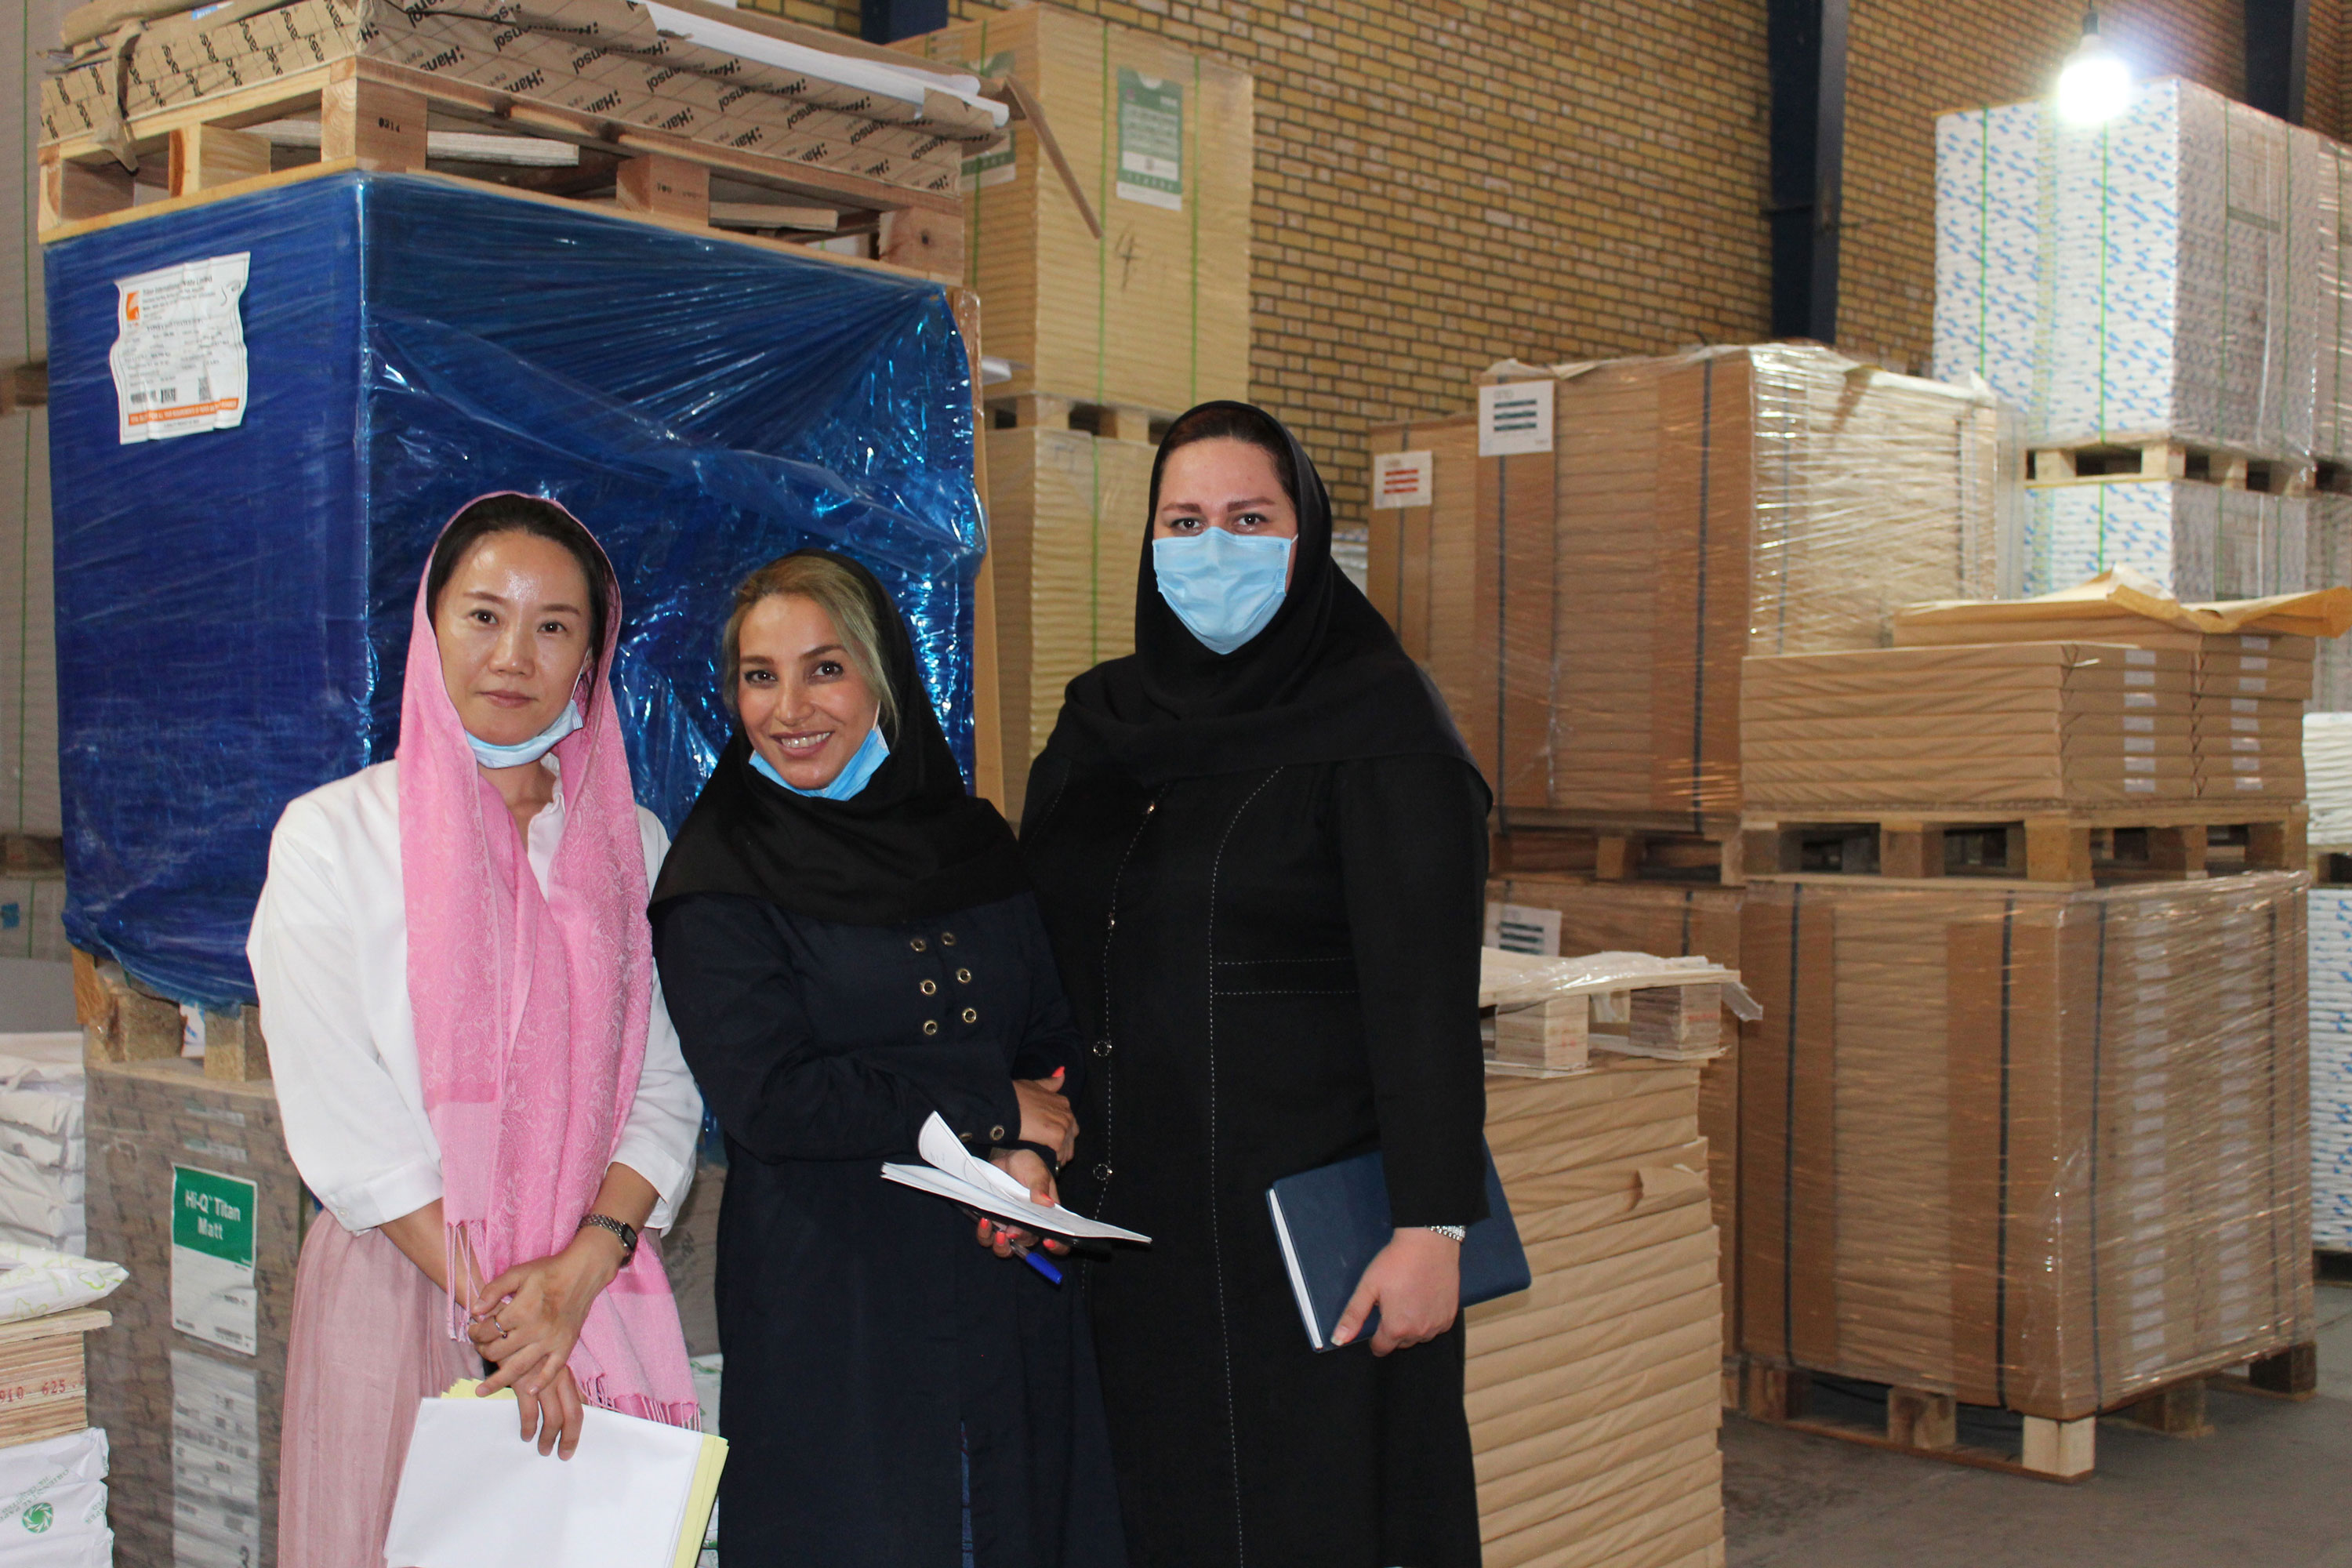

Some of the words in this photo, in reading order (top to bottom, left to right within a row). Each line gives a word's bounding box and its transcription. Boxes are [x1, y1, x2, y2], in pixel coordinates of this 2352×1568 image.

[213, 1196, 241, 1222] Titan
[198, 1215, 223, 1240] Matt
[42, 1380, 66, 1395] 625
